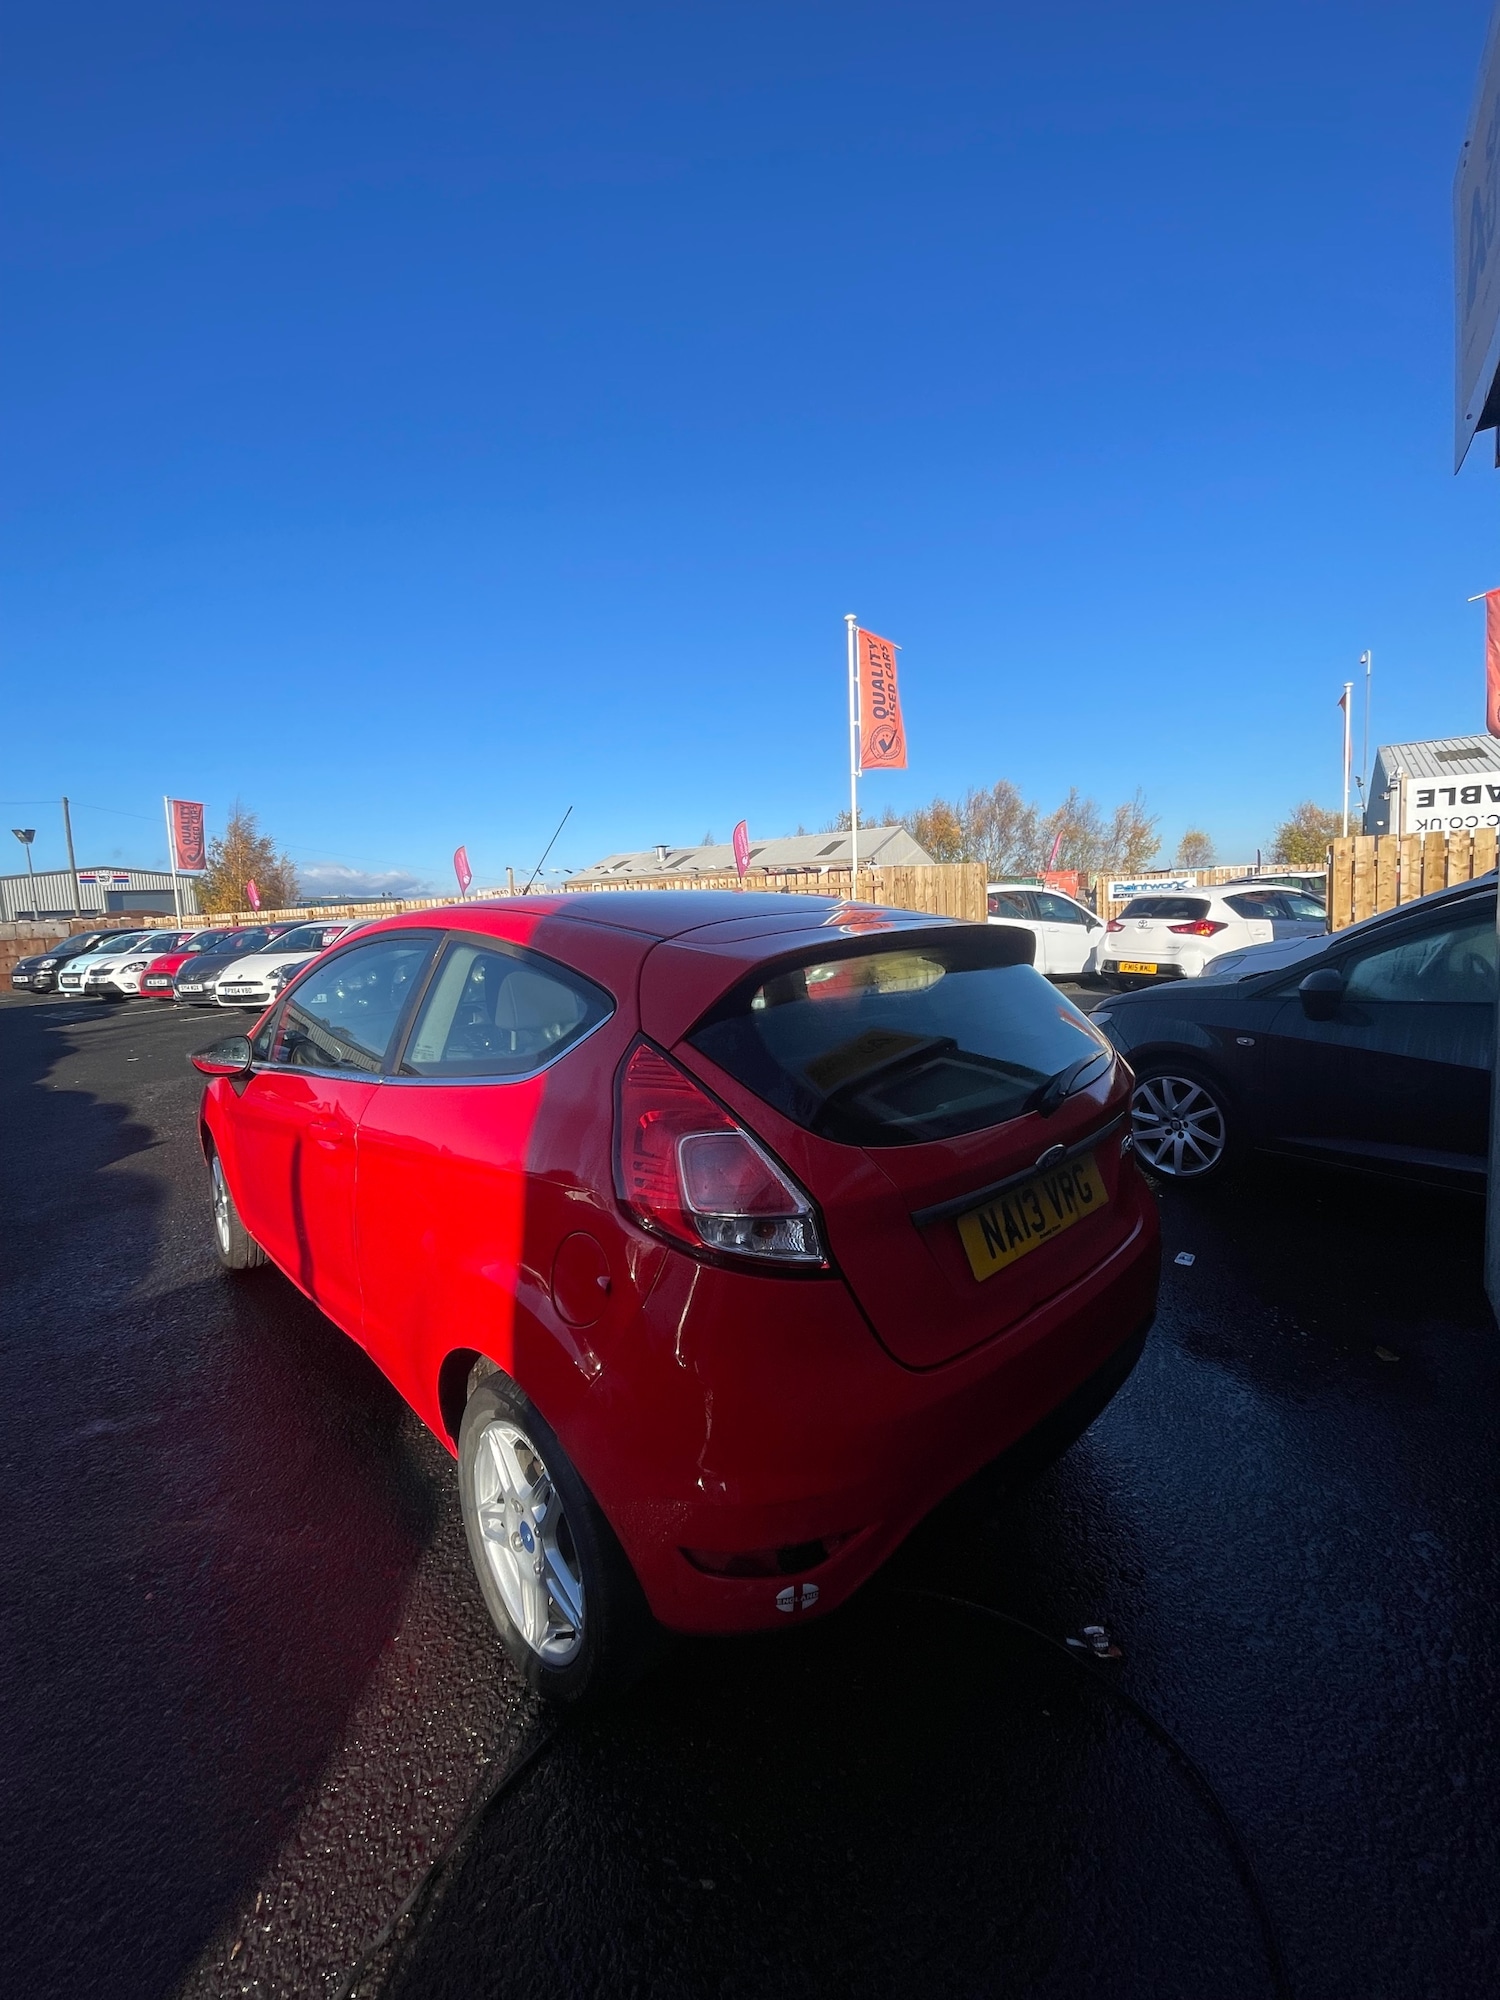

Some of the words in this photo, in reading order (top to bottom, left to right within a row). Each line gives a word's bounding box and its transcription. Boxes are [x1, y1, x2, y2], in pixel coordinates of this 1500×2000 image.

[867, 638, 890, 720] QUALITY
[880, 643, 894, 680] CARS
[888, 683, 897, 723] USED
[190, 805, 199, 824] CARS
[1416, 784, 1500, 808] ABLE
[180, 804, 193, 845] QUALITY
[192, 826, 201, 846] USED
[978, 1188, 1046, 1260] NA13
[776, 1591, 819, 1605] ENGLAND
